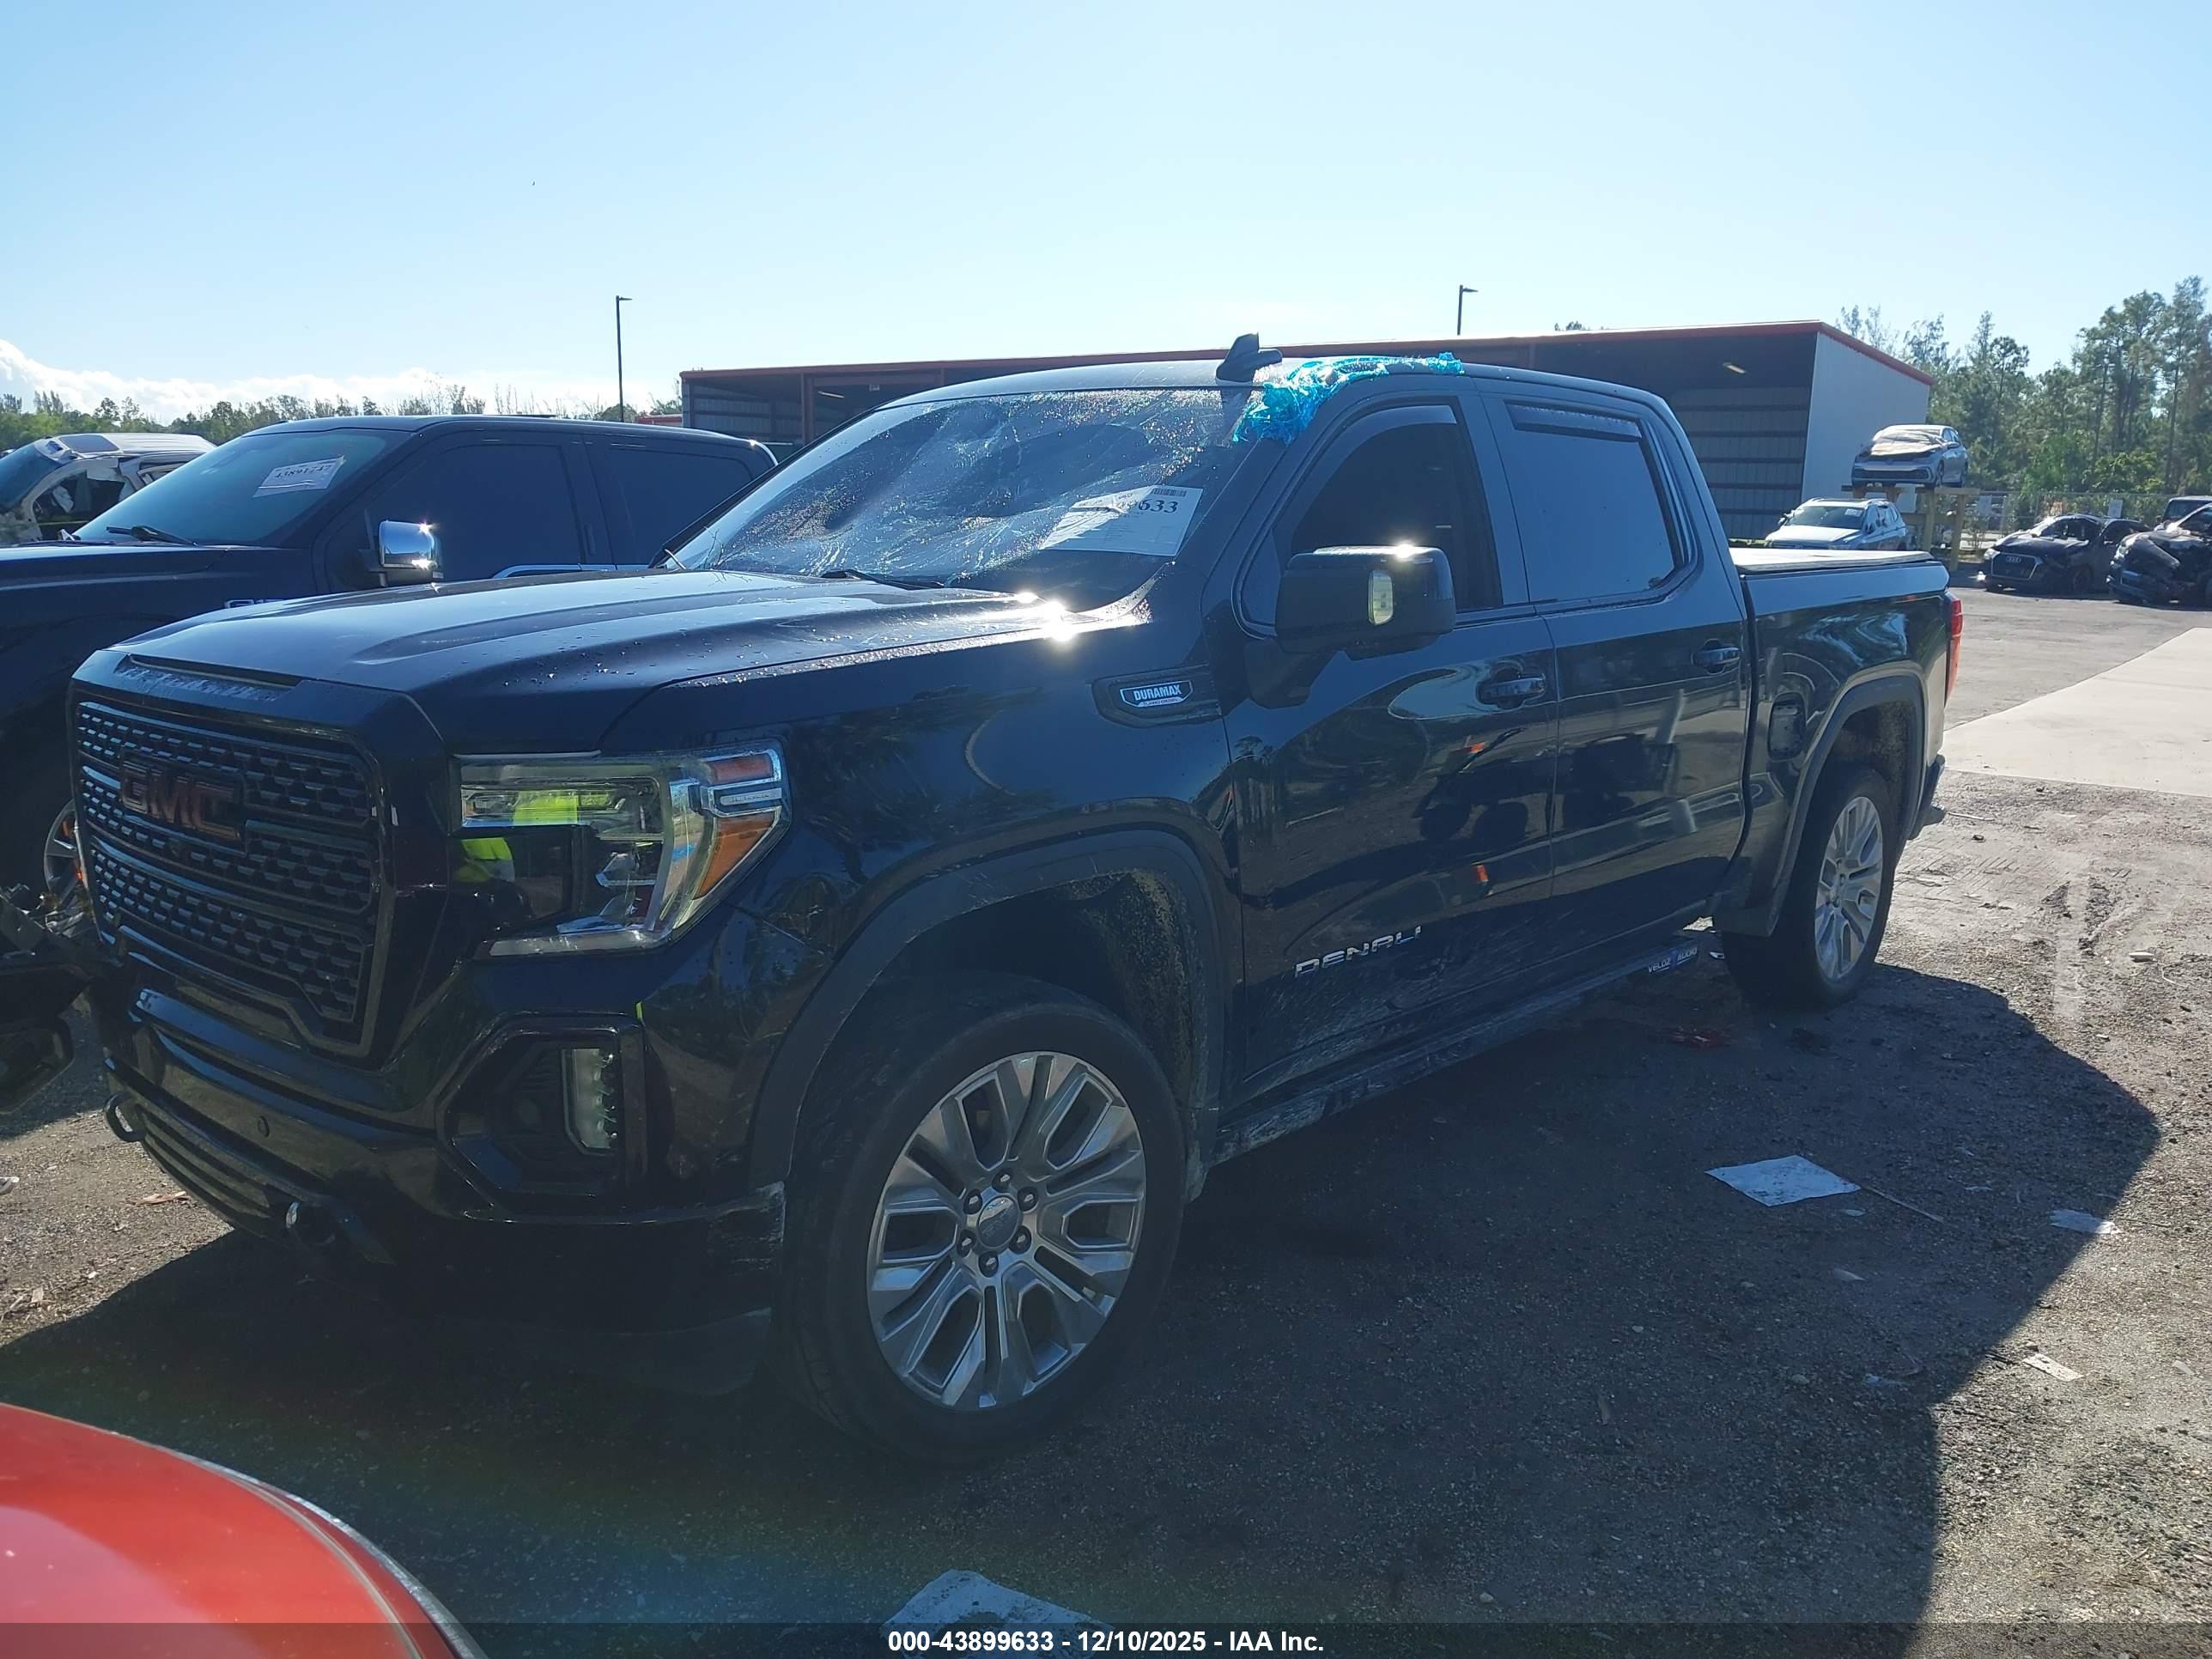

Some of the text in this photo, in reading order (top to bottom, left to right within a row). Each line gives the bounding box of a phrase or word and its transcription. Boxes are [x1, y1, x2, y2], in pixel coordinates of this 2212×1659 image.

[1133, 684, 1182, 702] DURAMAX
[122, 760, 241, 840] GMC
[1294, 926, 1422, 978] DENALI
